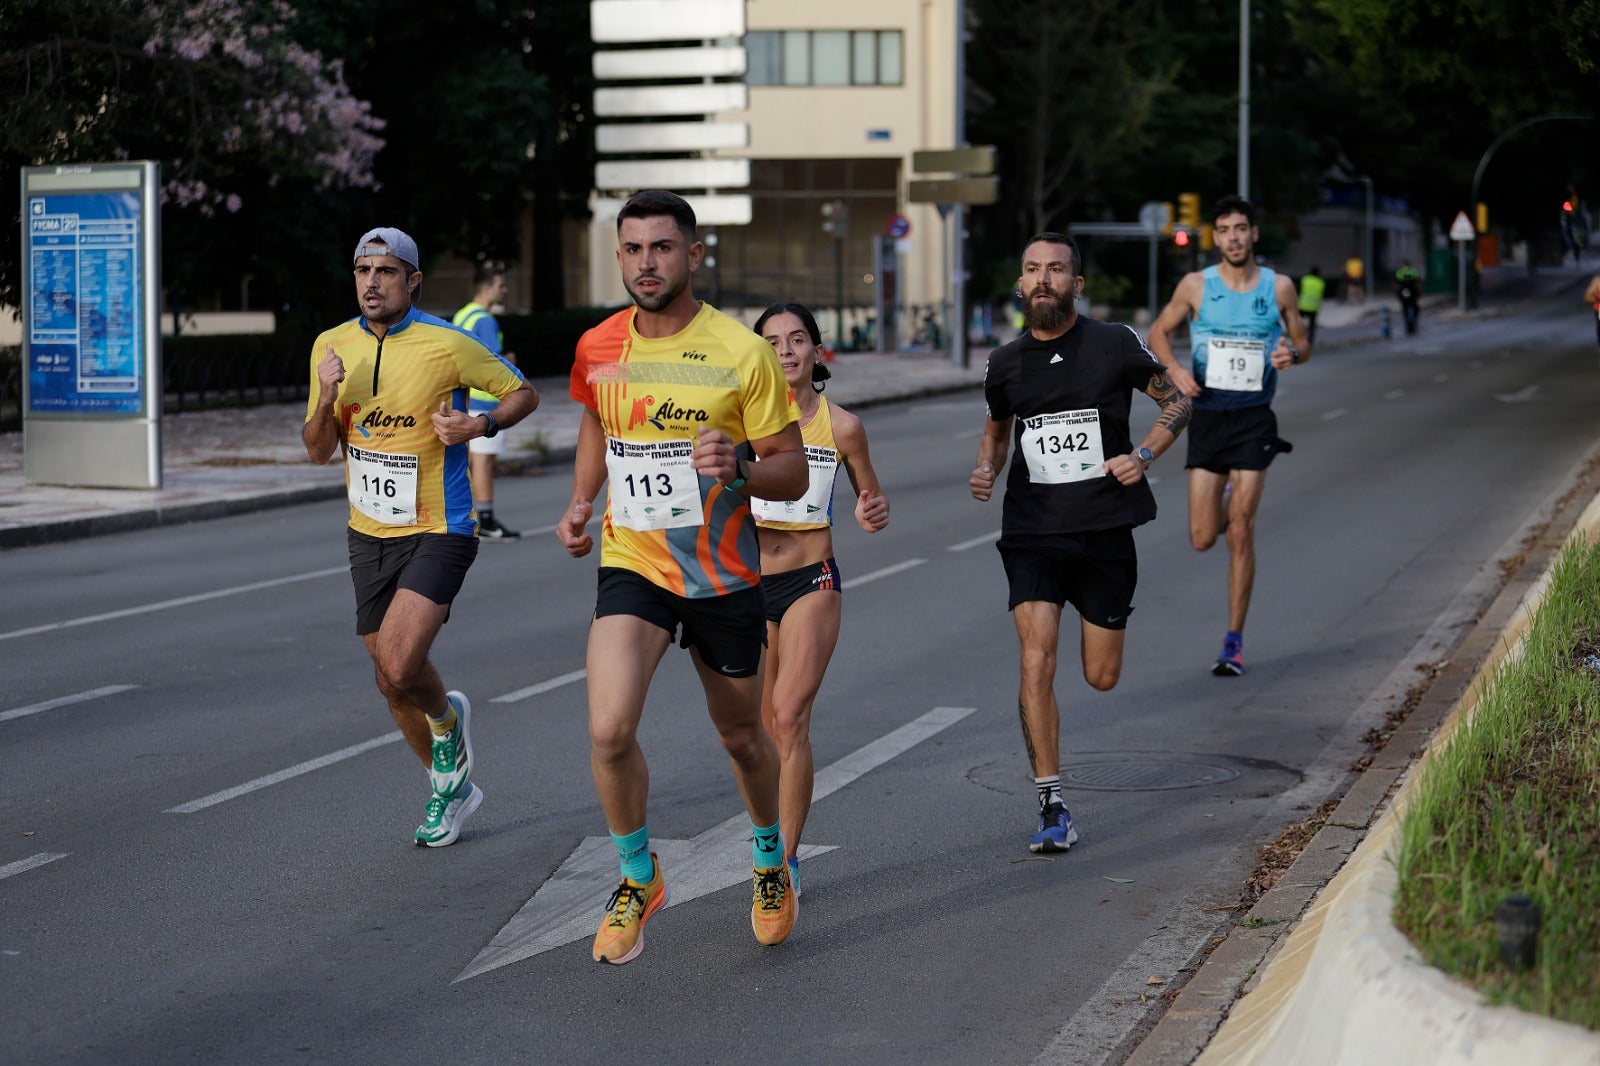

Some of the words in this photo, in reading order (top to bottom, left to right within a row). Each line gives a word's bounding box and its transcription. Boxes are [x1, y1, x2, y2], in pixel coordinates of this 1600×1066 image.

[1229, 358, 1246, 371] 19
[362, 406, 416, 428] Álora
[655, 398, 709, 421] Álora
[1027, 416, 1043, 430] 43
[1066, 417, 1098, 425] MALAGA
[609, 439, 624, 458] 43
[625, 443, 657, 451] CARRERA
[658, 441, 692, 450] URBANA
[1036, 432, 1089, 454] 1342
[347, 445, 361, 461] 43
[383, 460, 417, 469] MALAGA
[362, 474, 396, 498] 116
[625, 473, 673, 497] 113
